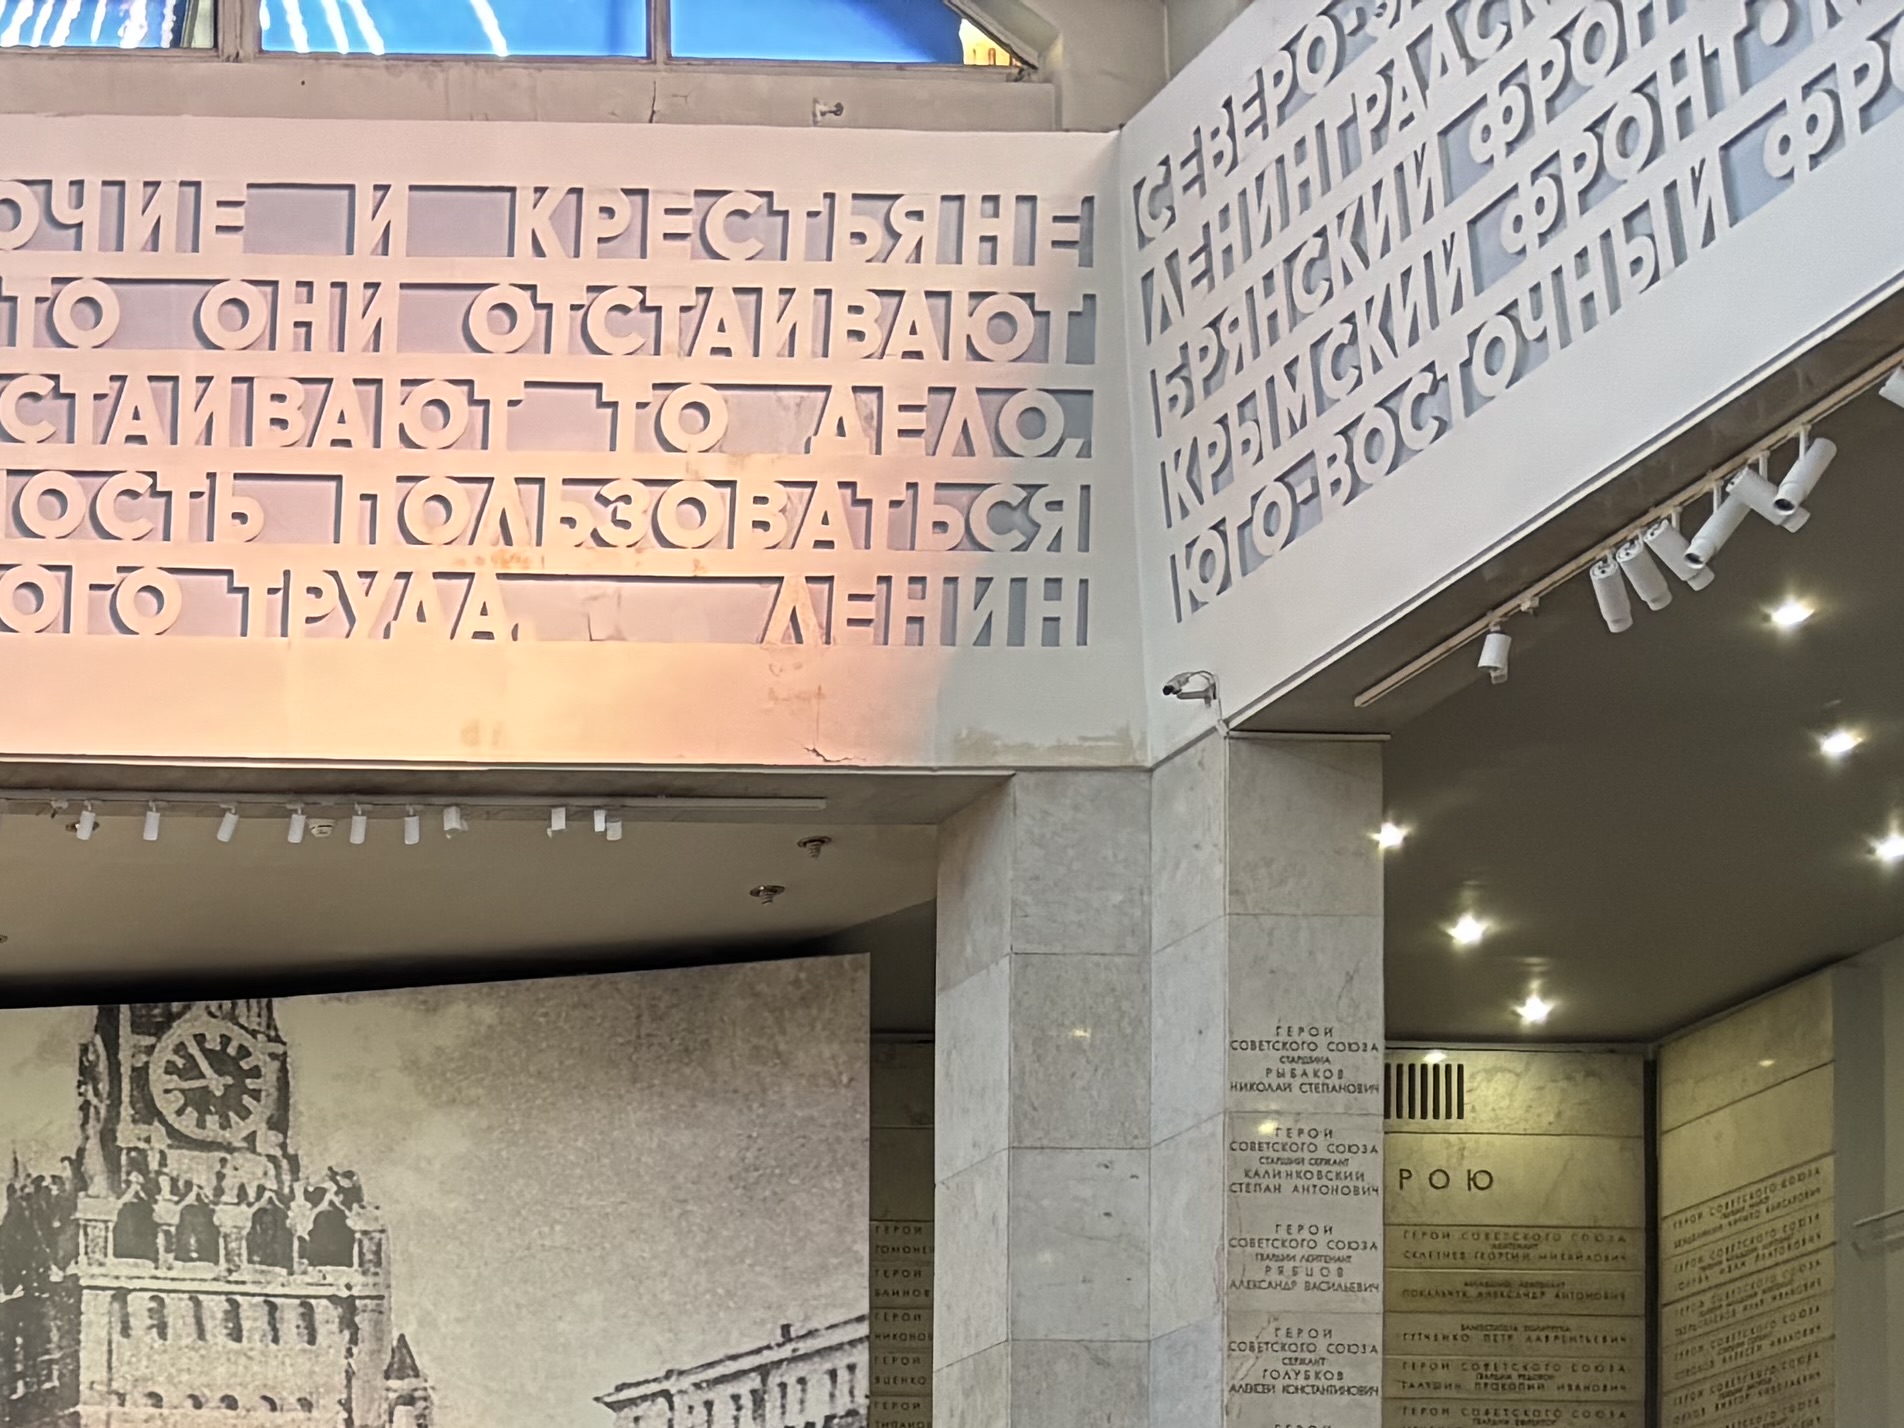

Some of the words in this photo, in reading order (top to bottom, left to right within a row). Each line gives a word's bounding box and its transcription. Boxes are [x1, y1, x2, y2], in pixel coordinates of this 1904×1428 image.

[356, 184, 406, 256] И
[514, 188, 1085, 267] КРЕСТЬЯНЕ
[196, 279, 388, 353] ОНИ
[465, 284, 1090, 364] ОТСТАИВАЮТ
[1156, 145, 1442, 432] БРЯНСКИЙ
[1169, 230, 1475, 527] КРЫМСКИЙ
[1180, 150, 1730, 612] ЮГО-ВОСТОЧНЫЙ
[594, 382, 729, 453] ТО
[807, 386, 1085, 459] ДЕЛО,
[350, 475, 1090, 553] ПОЛЬЗОВАТЬСЯ
[762, 576, 1074, 647] ЛЕНИН
[1229, 1040, 1319, 1052] СОВЕТСКОГО
[1326, 1041, 1379, 1053] СОЮЗА
[1265, 1068, 1345, 1080] РЫБАКОВ
[1298, 1082, 1379, 1094] СТЕПАНОВИЧ
[1228, 1141, 1318, 1153] СОВЕТСКОГО
[1326, 1143, 1379, 1155] СОЮЗА
[1228, 1182, 1281, 1194] СТЕПАН
[1292, 1183, 1379, 1196] АНТОНОВИЧ
